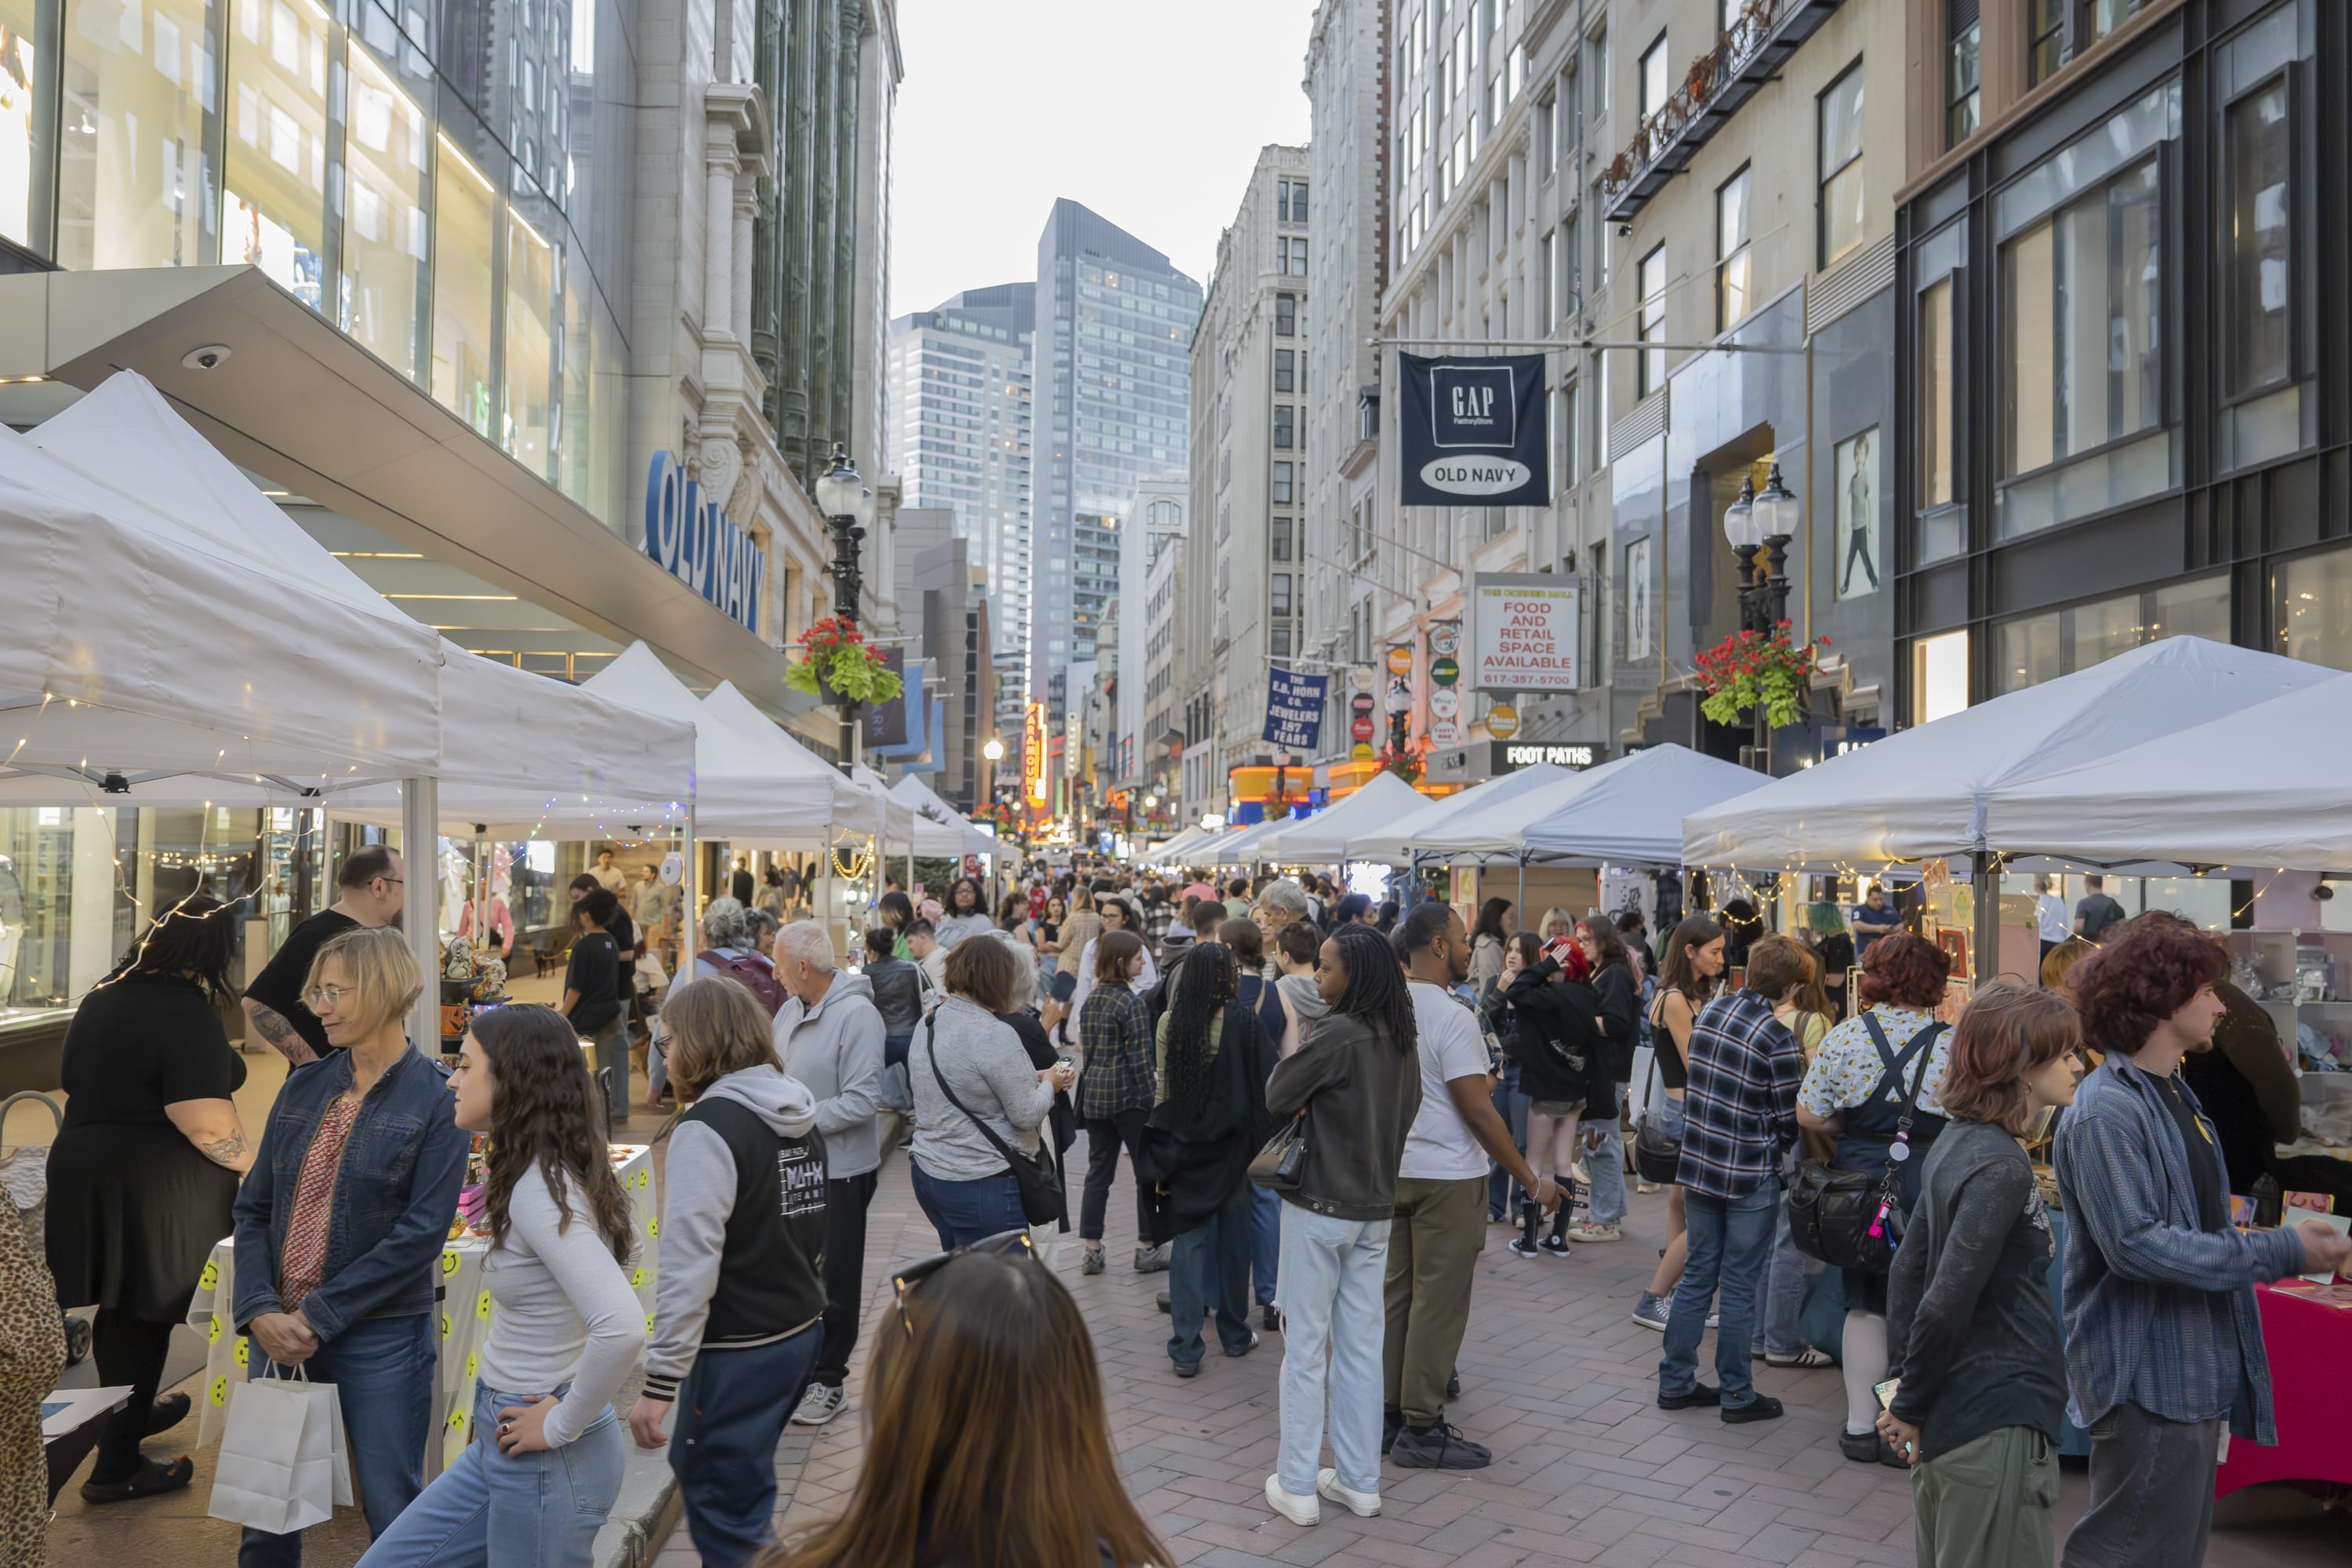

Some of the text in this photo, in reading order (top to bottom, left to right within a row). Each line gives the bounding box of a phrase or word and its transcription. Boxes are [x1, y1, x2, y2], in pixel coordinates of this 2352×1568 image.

[1452, 387, 1494, 416] GAP
[1435, 468, 1515, 482] OLD NAVY
[646, 450, 765, 639] OLD NAVY
[1504, 602, 1552, 613] FOOD
[1511, 615, 1546, 626] AND
[1500, 628, 1555, 640] RETAIL
[1499, 642, 1555, 654] SPACE
[1483, 655, 1571, 668] AVAILABLE
[1290, 675, 1305, 685] THE
[1292, 685, 1320, 698] HORN
[1269, 705, 1319, 723] JEWELERS
[1281, 720, 1301, 733] 187
[1273, 730, 1308, 746] YEARS
[1026, 703, 1037, 797] PARAMOUNT
[1507, 746, 1593, 765] FOOT PATHS
